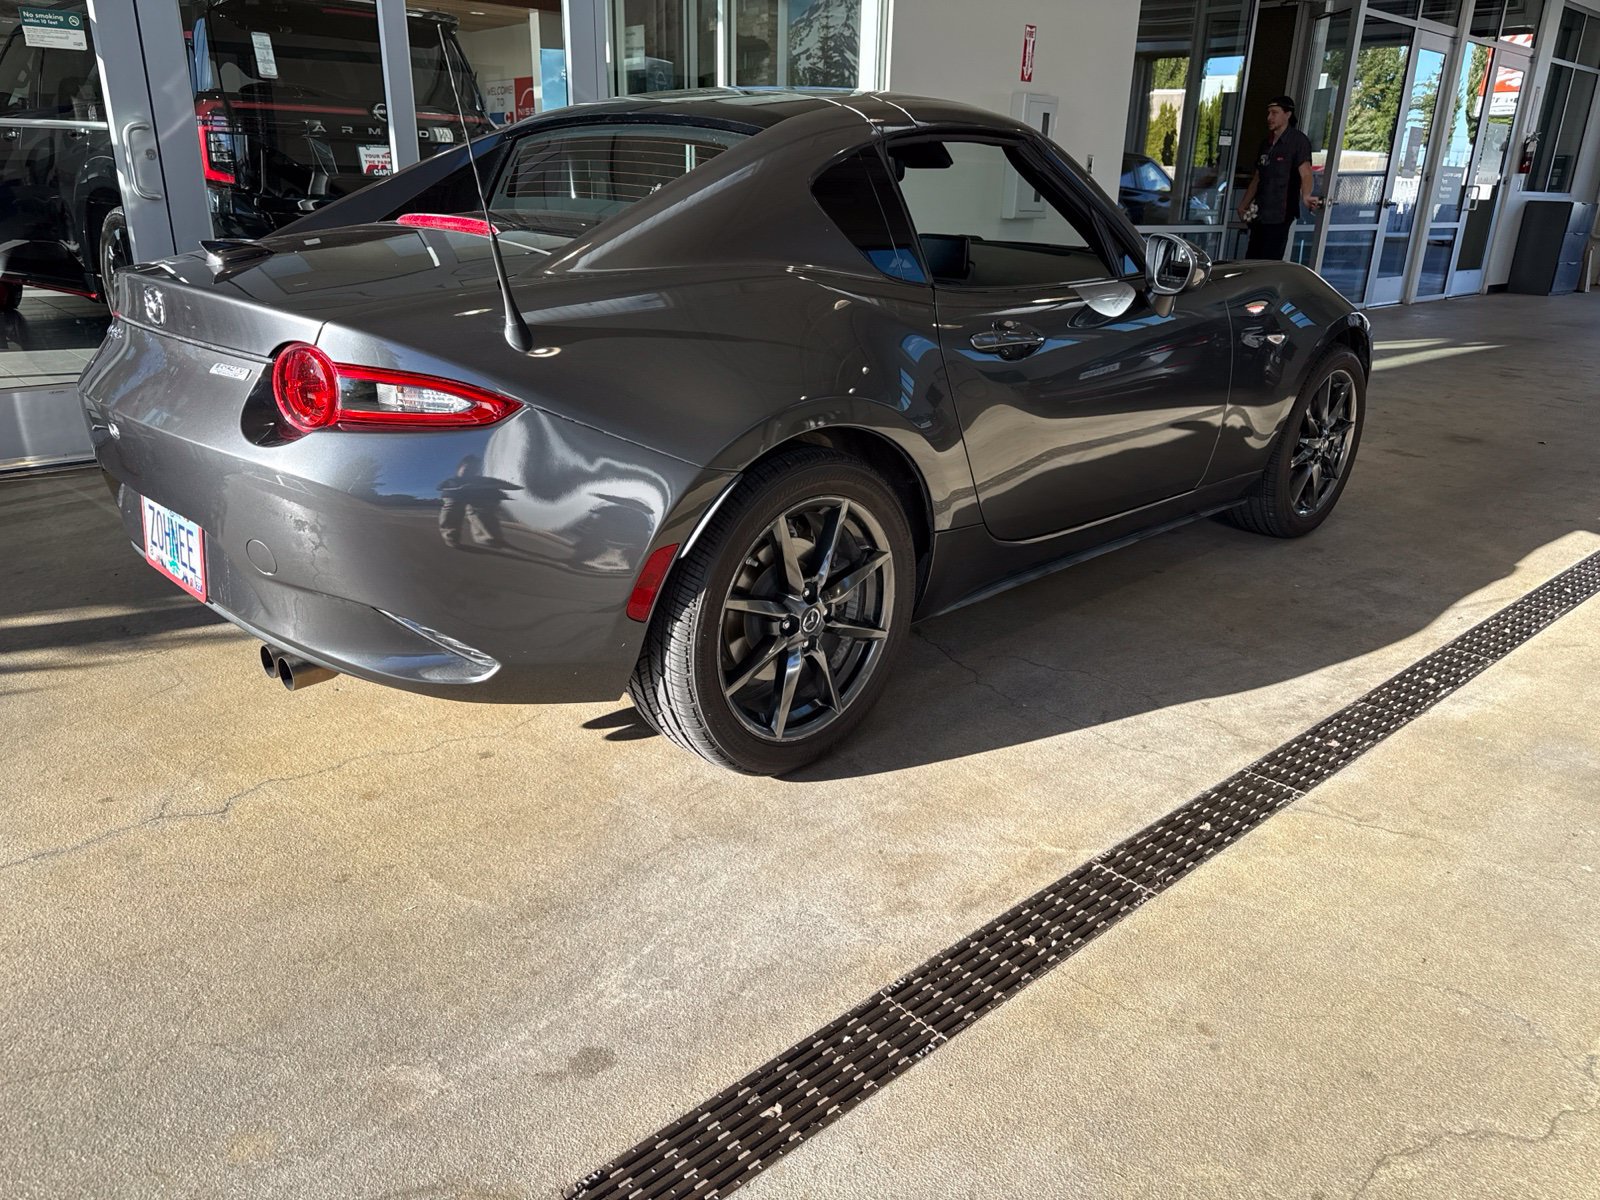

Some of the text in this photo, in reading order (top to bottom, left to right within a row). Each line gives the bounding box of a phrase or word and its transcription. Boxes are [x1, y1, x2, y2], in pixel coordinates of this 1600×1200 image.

[487, 85, 513, 96] WELCOME
[496, 97, 505, 107] TO
[148, 504, 196, 574] ZOHNEE
